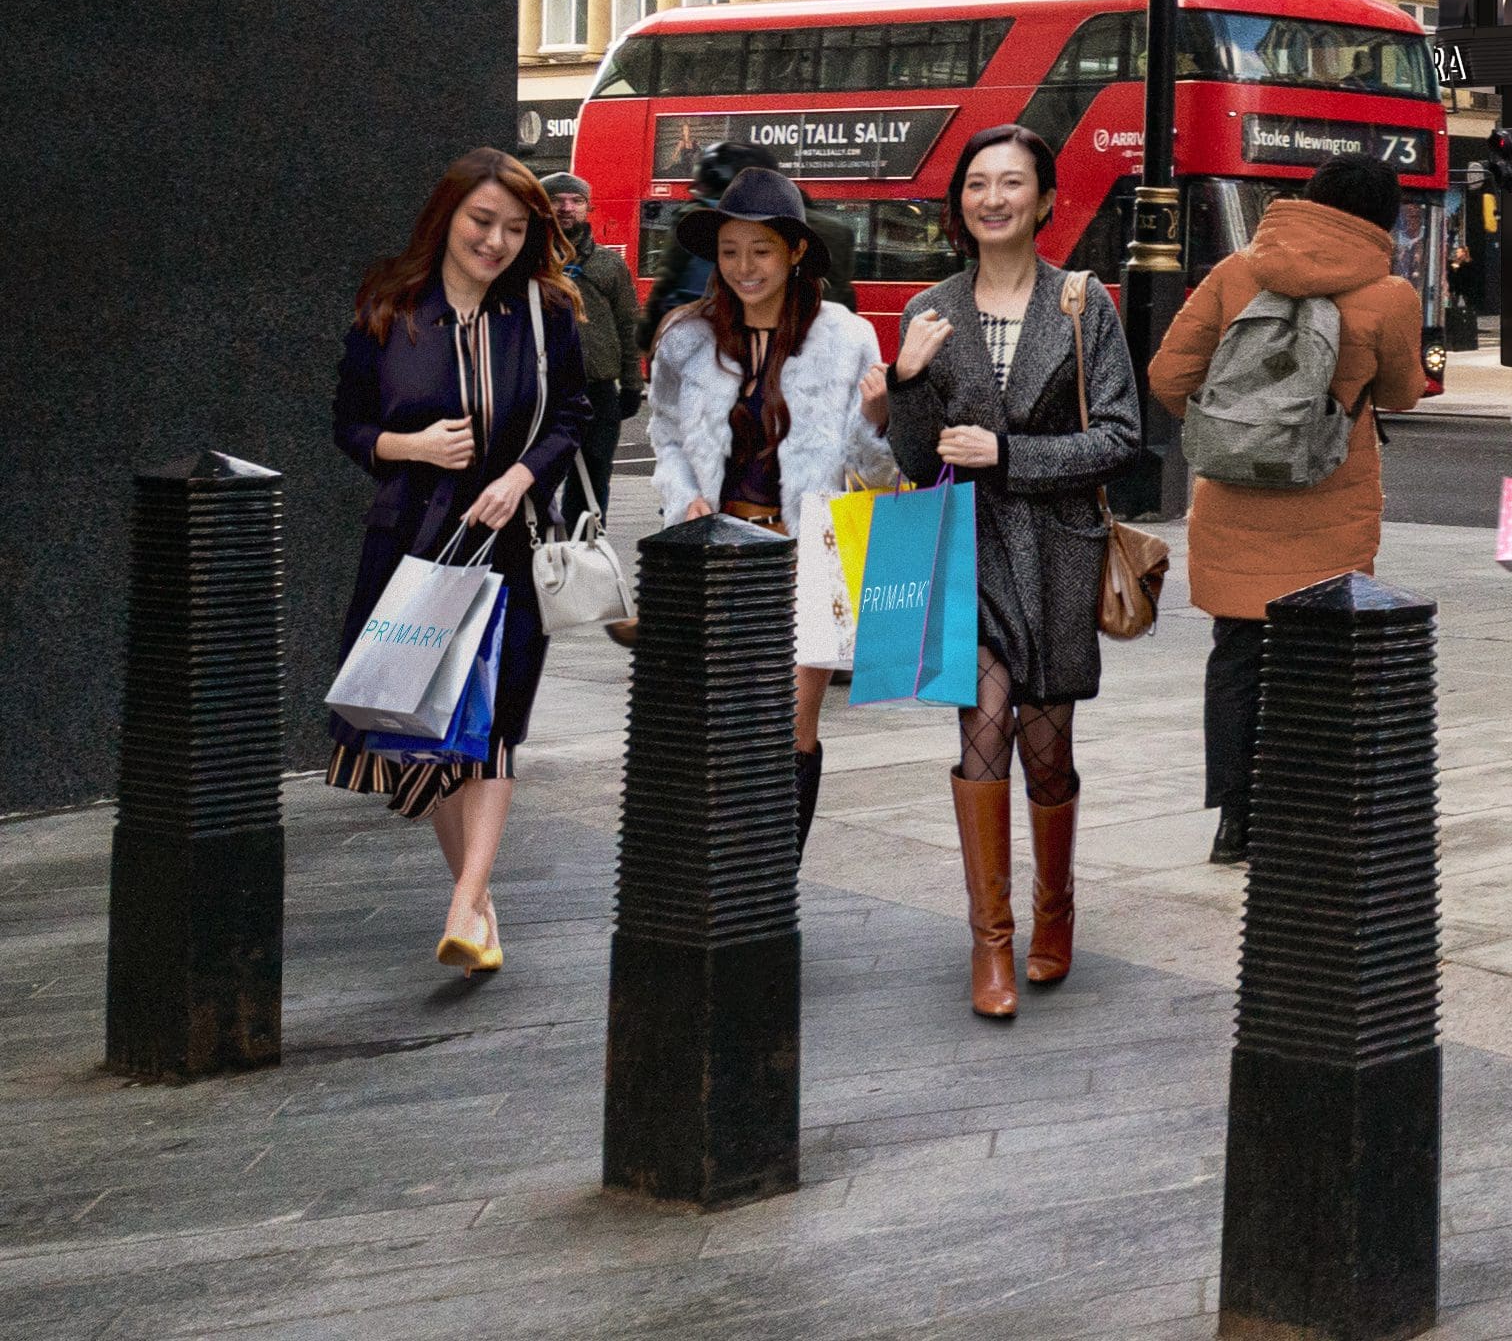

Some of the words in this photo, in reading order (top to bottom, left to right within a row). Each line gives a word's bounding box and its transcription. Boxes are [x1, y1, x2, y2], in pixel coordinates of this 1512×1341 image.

[750, 124, 799, 146] LONG
[805, 122, 848, 145] TALL
[854, 121, 911, 144] SALLY
[1110, 130, 1145, 147] ARRIV
[1254, 127, 1290, 148] Stoke
[1295, 130, 1361, 155] Newington
[1381, 134, 1418, 164] 73
[862, 580, 928, 613] PRIMARK
[360, 619, 451, 649] PRIMARK
